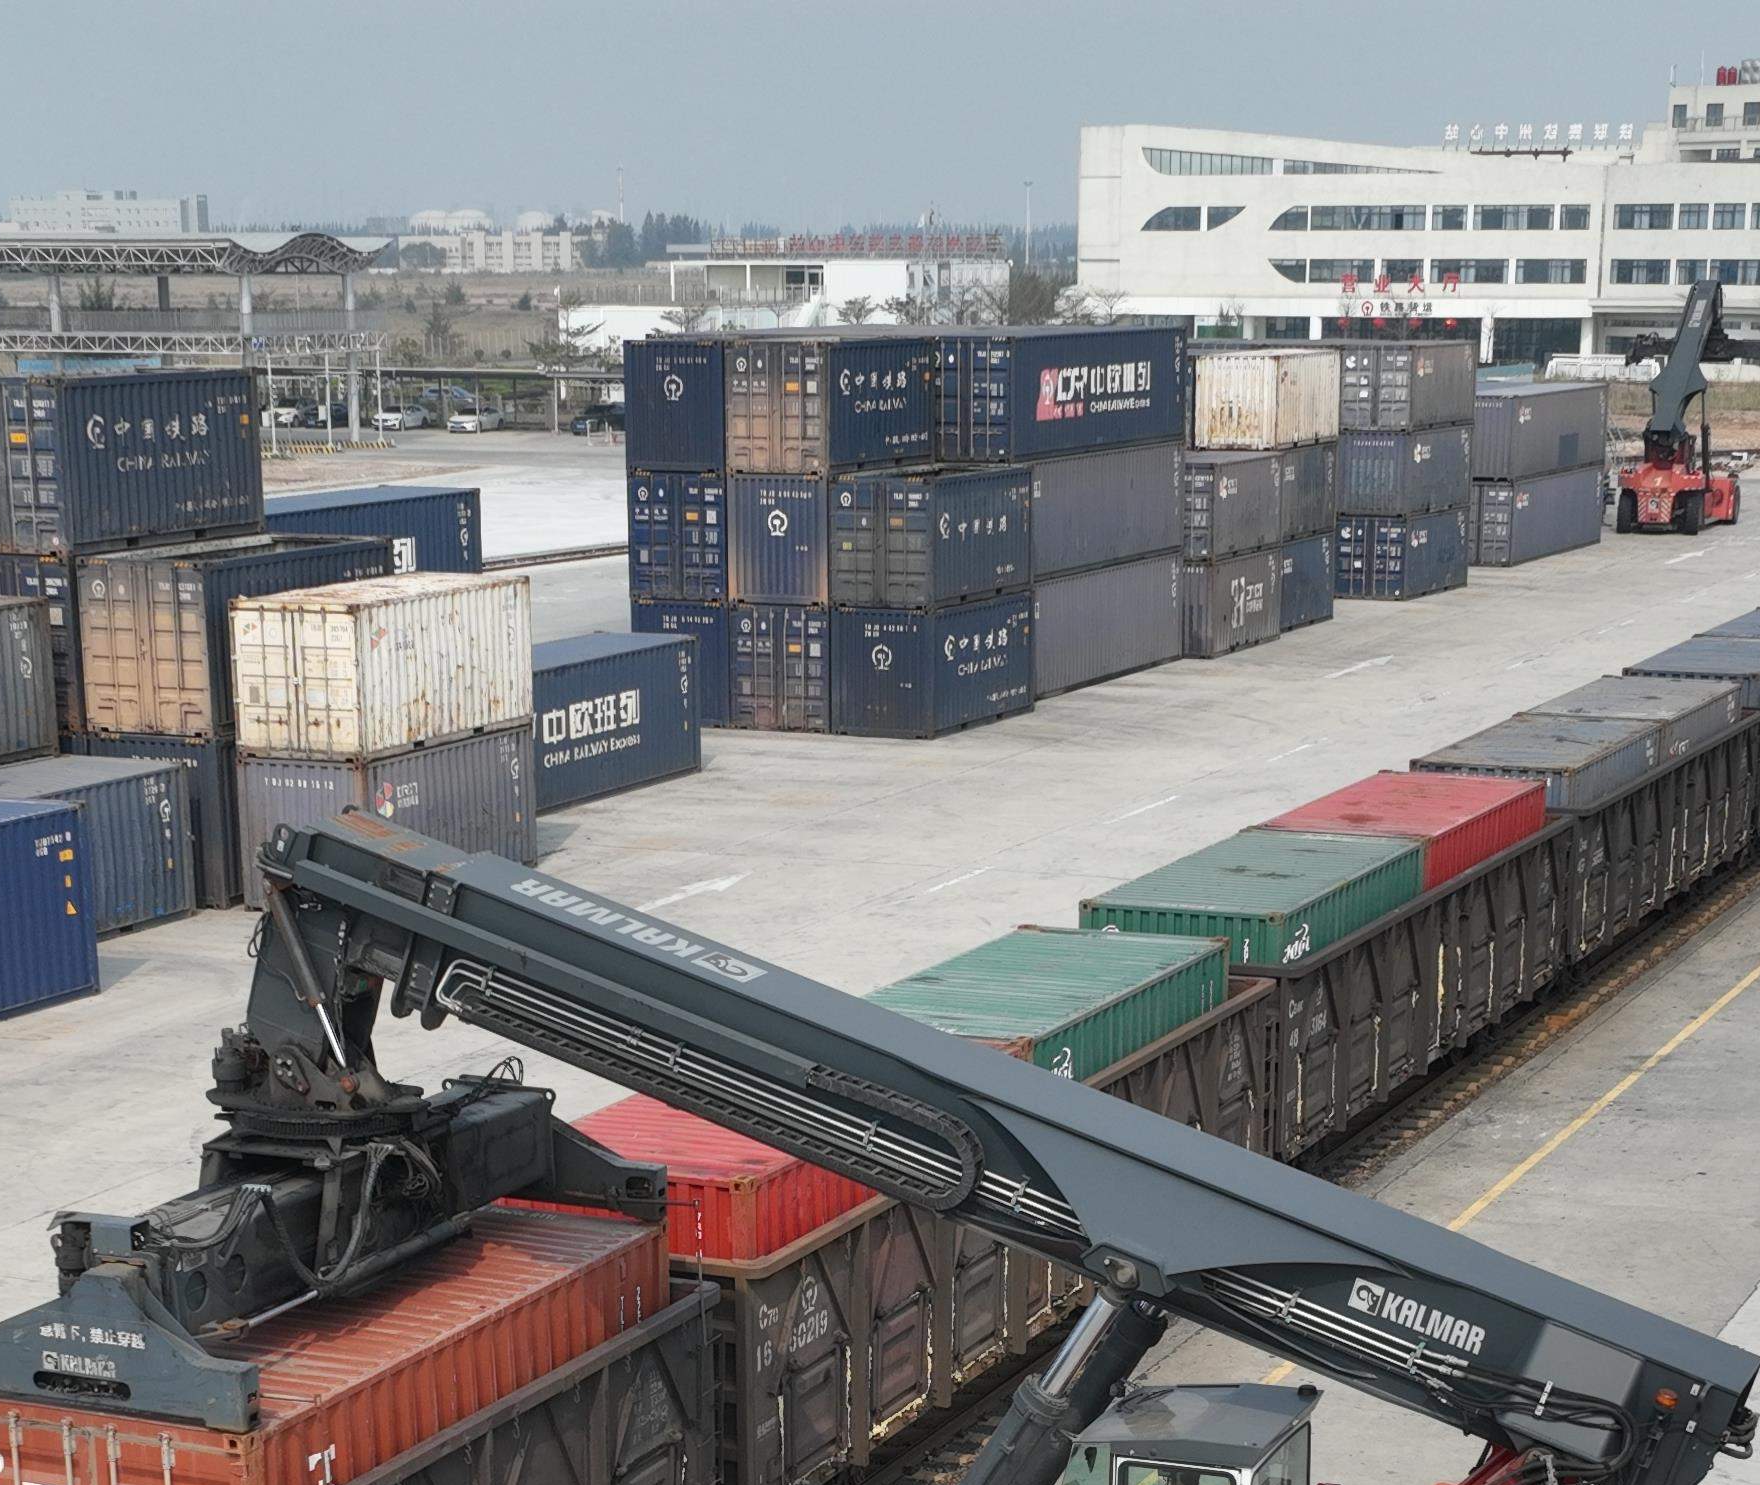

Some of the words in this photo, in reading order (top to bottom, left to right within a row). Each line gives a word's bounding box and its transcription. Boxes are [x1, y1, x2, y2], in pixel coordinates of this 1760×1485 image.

[1341, 272, 1461, 293] 营业大厅
[543, 689, 640, 744] 中欧班列
[1380, 1289, 1487, 1356] KALMAR
